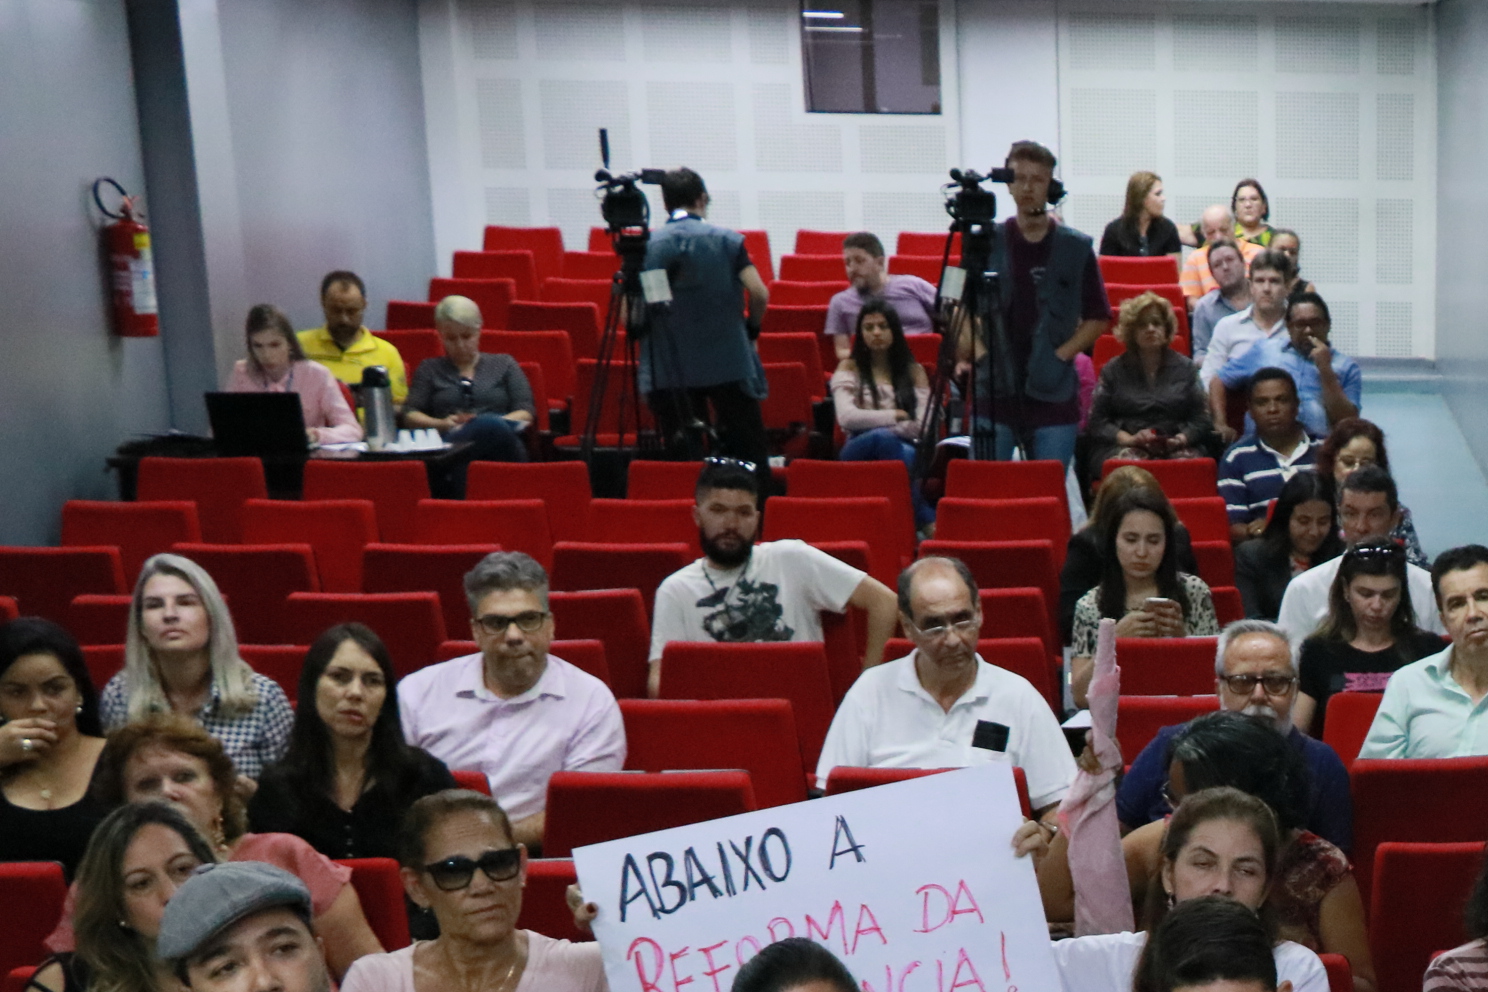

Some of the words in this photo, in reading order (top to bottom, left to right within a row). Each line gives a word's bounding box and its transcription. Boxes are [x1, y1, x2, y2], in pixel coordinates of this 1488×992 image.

[619, 827, 793, 923] ABAIXO
[829, 814, 866, 870] A
[912, 879, 985, 934] DA
